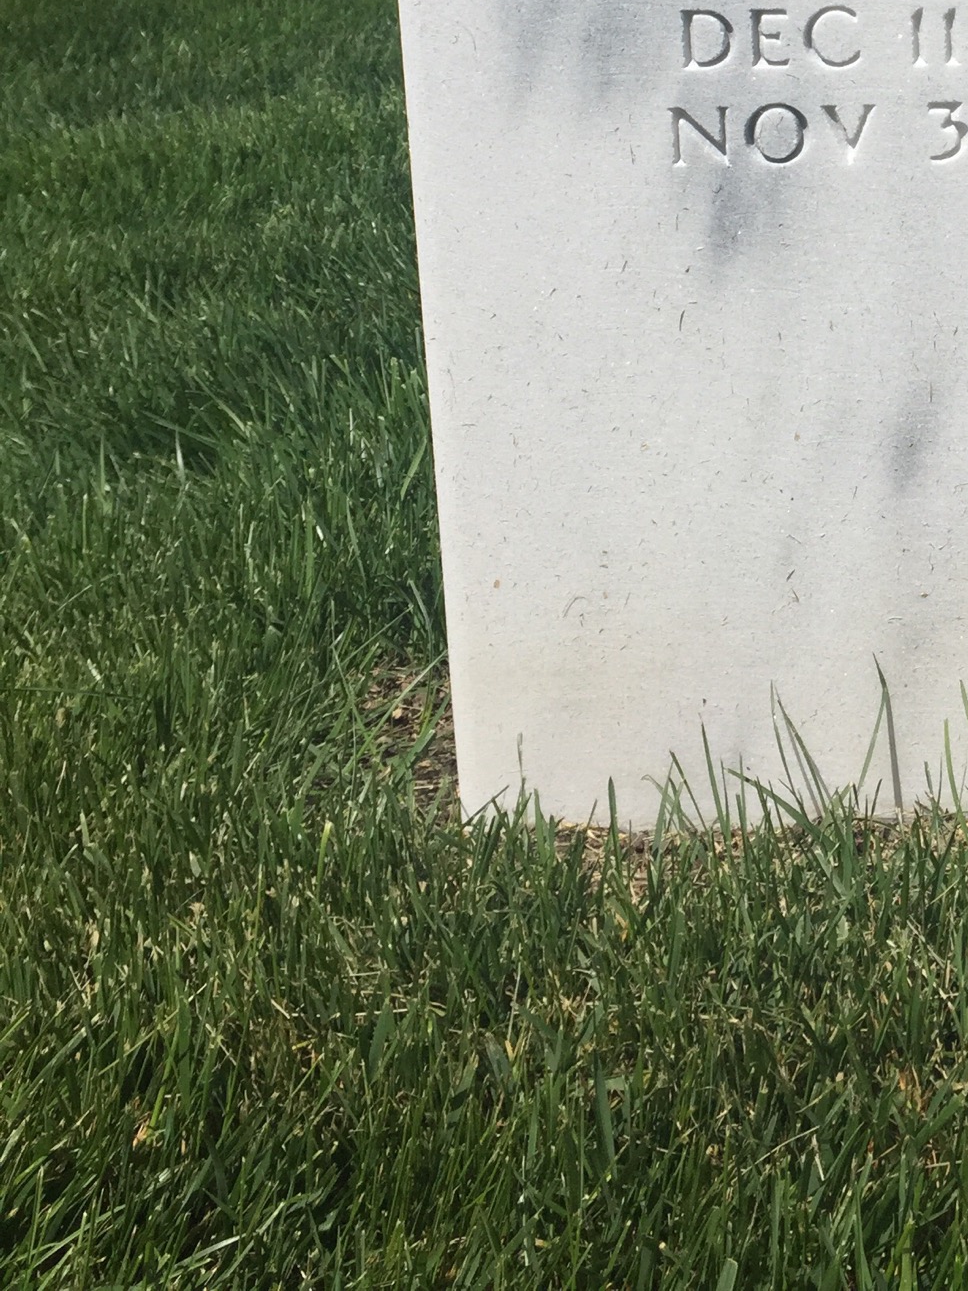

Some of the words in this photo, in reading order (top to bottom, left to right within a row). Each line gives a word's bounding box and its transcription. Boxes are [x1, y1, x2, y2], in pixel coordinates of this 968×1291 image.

[680, 4, 862, 69] DEC
[910, 6, 958, 67] 11
[668, 101, 876, 166] NOV
[927, 100, 968, 162] 3
